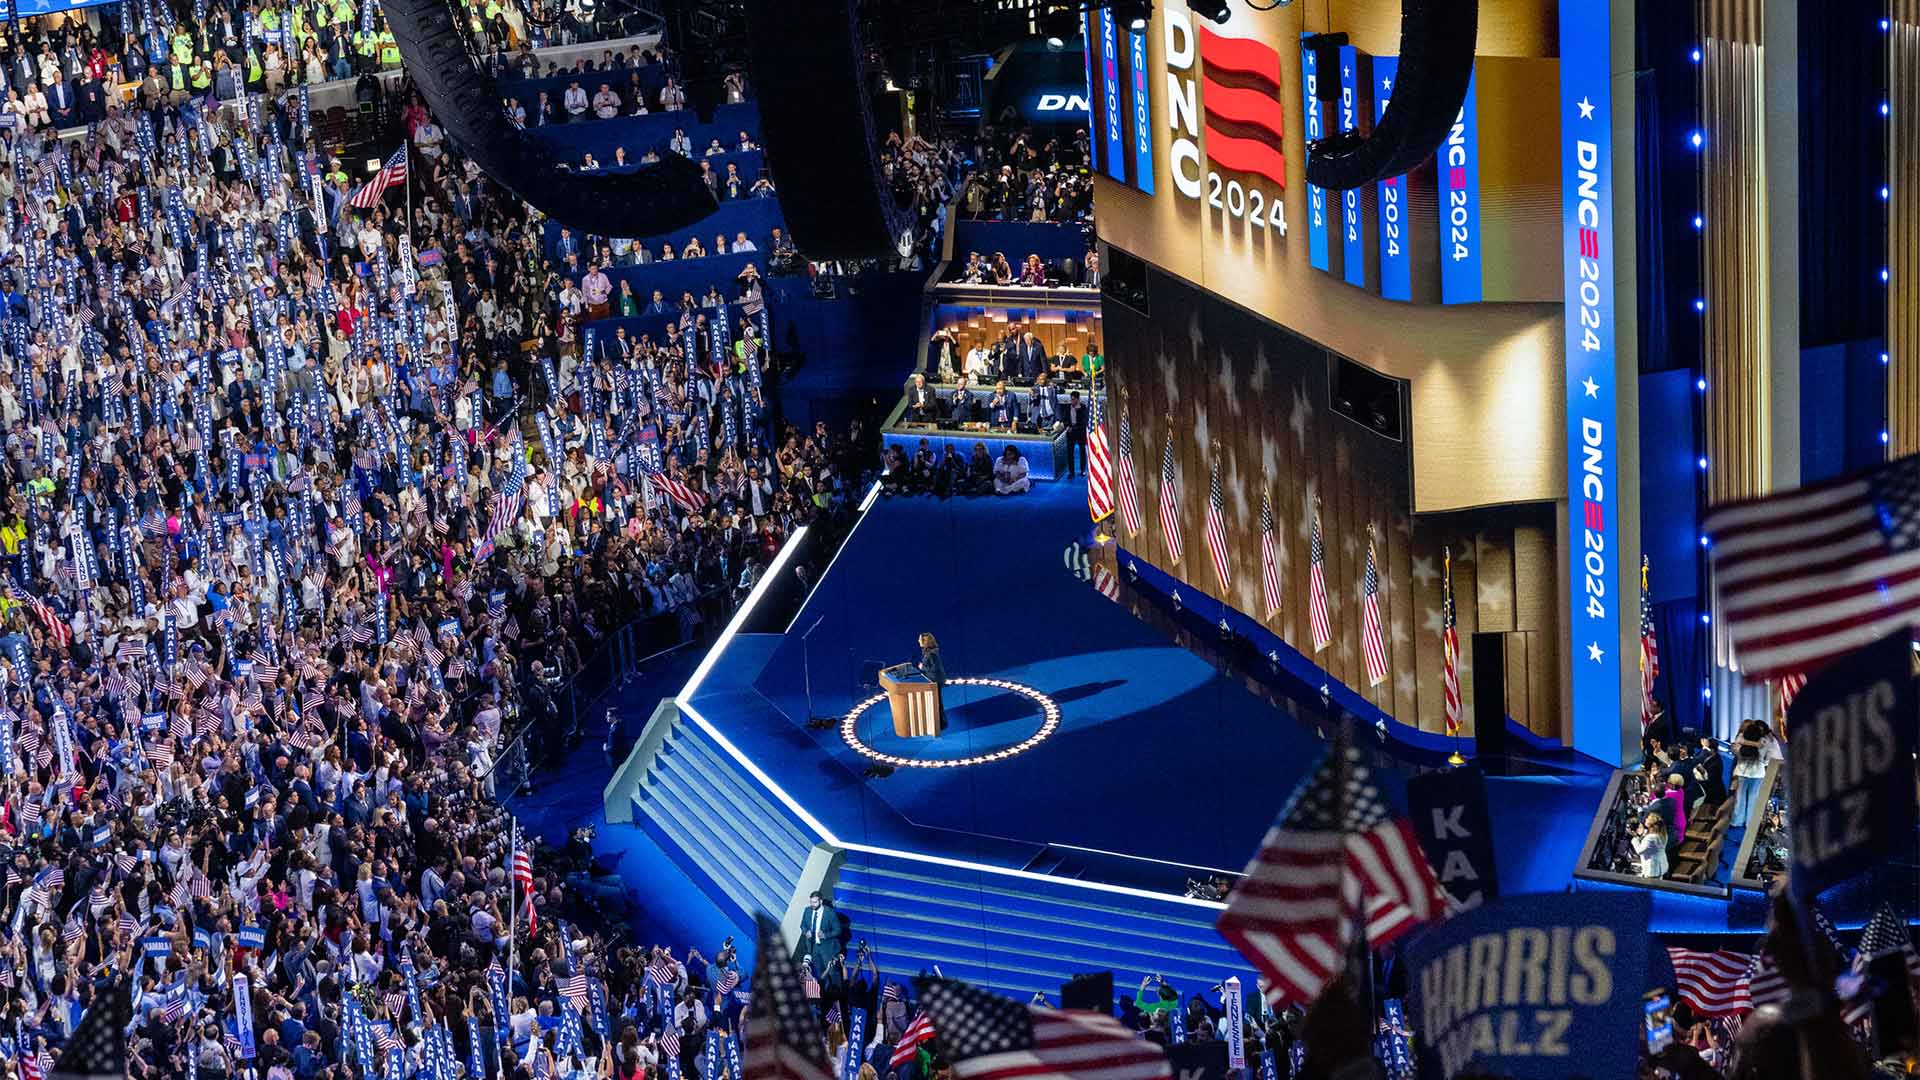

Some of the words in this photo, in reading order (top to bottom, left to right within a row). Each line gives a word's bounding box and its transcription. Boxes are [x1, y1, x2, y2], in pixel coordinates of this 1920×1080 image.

[282, 14, 291, 48] KAMALA
[1134, 35, 1143, 73] NC
[234, 70, 245, 111] HAWAII
[1037, 95, 1089, 111] DN
[1164, 8, 1200, 198] DNC
[1307, 75, 1318, 138] DNC
[1343, 87, 1353, 130] DN
[249, 95, 258, 129] KAMALA
[1108, 80, 1119, 142] 2024
[1137, 93, 1148, 154] 2024
[142, 115, 154, 146] KAMALA
[196, 117, 208, 151] KAMALA
[16, 147, 25, 180] KAMALA
[236, 141, 250, 176] KAMALA
[269, 149, 277, 184] KAMALA
[297, 154, 308, 187] KAMALA
[259, 162, 269, 196] KAMALA
[1577, 140, 1598, 228] DNC
[140, 190, 148, 223] KAMALA
[174, 194, 190, 226] KAMALA
[1207, 172, 1287, 237] 2024
[1347, 190, 1357, 242] 024
[1385, 188, 1400, 257] 2024
[168, 208, 180, 244] KAMALA
[244, 225, 252, 259] KAMALA
[1450, 191, 1468, 262] 2024
[45, 244, 55, 277] KAMALA
[225, 236, 238, 270] KAMALA
[376, 250, 386, 286] KAMALA
[401, 240, 414, 286] MONTANA
[65, 264, 74, 299] KAMALA
[210, 274, 225, 303] KAMALA
[42, 290, 51, 325] KAMALA
[51, 305, 66, 341] KAMALA
[181, 301, 194, 337] KAMALA
[251, 292, 262, 327] KAMALA
[368, 297, 376, 326] KAMALA
[398, 302, 407, 338] KAMALA
[445, 288, 457, 332] MAINE
[1580, 259, 1600, 352] 2024
[156, 325, 170, 360] KAMALA
[413, 309, 423, 344] KAMALA
[712, 323, 722, 358] KAMALA
[133, 337, 144, 371] KAMALA
[272, 329, 284, 365] KAMALA
[387, 327, 395, 363] KAMALA
[585, 333, 593, 367] KAMALA
[23, 367, 32, 400] KAMALA
[201, 355, 209, 389] KAMALA
[267, 351, 275, 387] KAMALA
[314, 369, 326, 402] KAMALA
[544, 362, 558, 395] KAMALA
[262, 385, 273, 422] KAMALA
[582, 375, 590, 410] KAMALA
[131, 397, 140, 433] KAMALA
[380, 399, 401, 434] KAMALA
[723, 407, 732, 442] KAMALA
[537, 416, 552, 454] KAMALA
[594, 423, 606, 458] KAMALA
[69, 453, 80, 489] KAMALA
[230, 453, 238, 488] KAMALA
[400, 447, 409, 483] KAMALA
[453, 445, 465, 481] KAMALA
[554, 439, 562, 474] KAMALA
[1582, 418, 1603, 502] DNC
[107, 512, 115, 548] KAMALA
[211, 515, 223, 548] KAMALA
[288, 502, 299, 536] KAMALA
[20, 543, 30, 580] KAMALA
[73, 533, 87, 580] MARYLAND
[82, 536, 97, 574] KAMALA
[122, 536, 133, 574] KAMALA
[252, 533, 262, 572] KAMALA
[271, 544, 285, 576] KAMALA
[1585, 531, 1605, 619] 2024
[133, 579, 143, 612] KAMALA
[284, 591, 295, 628] KAMALA
[376, 598, 386, 638] KAMALA
[166, 620, 174, 660] KAMALA
[15, 642, 29, 678] KAMALA
[2, 725, 13, 768] KAMALA
[405, 970, 421, 1022] KAMALA
[492, 975, 508, 1024] KAMALA
[1421, 925, 1617, 1047] HARRIS
[341, 997, 349, 1047] KAMALA
[589, 982, 604, 1029] KAMALA
[1230, 991, 1240, 1056] TENNESSEE
[352, 1007, 366, 1059] KAMALA
[468, 1023, 483, 1073] KAMALA
[1389, 1007, 1406, 1064] KAALA
